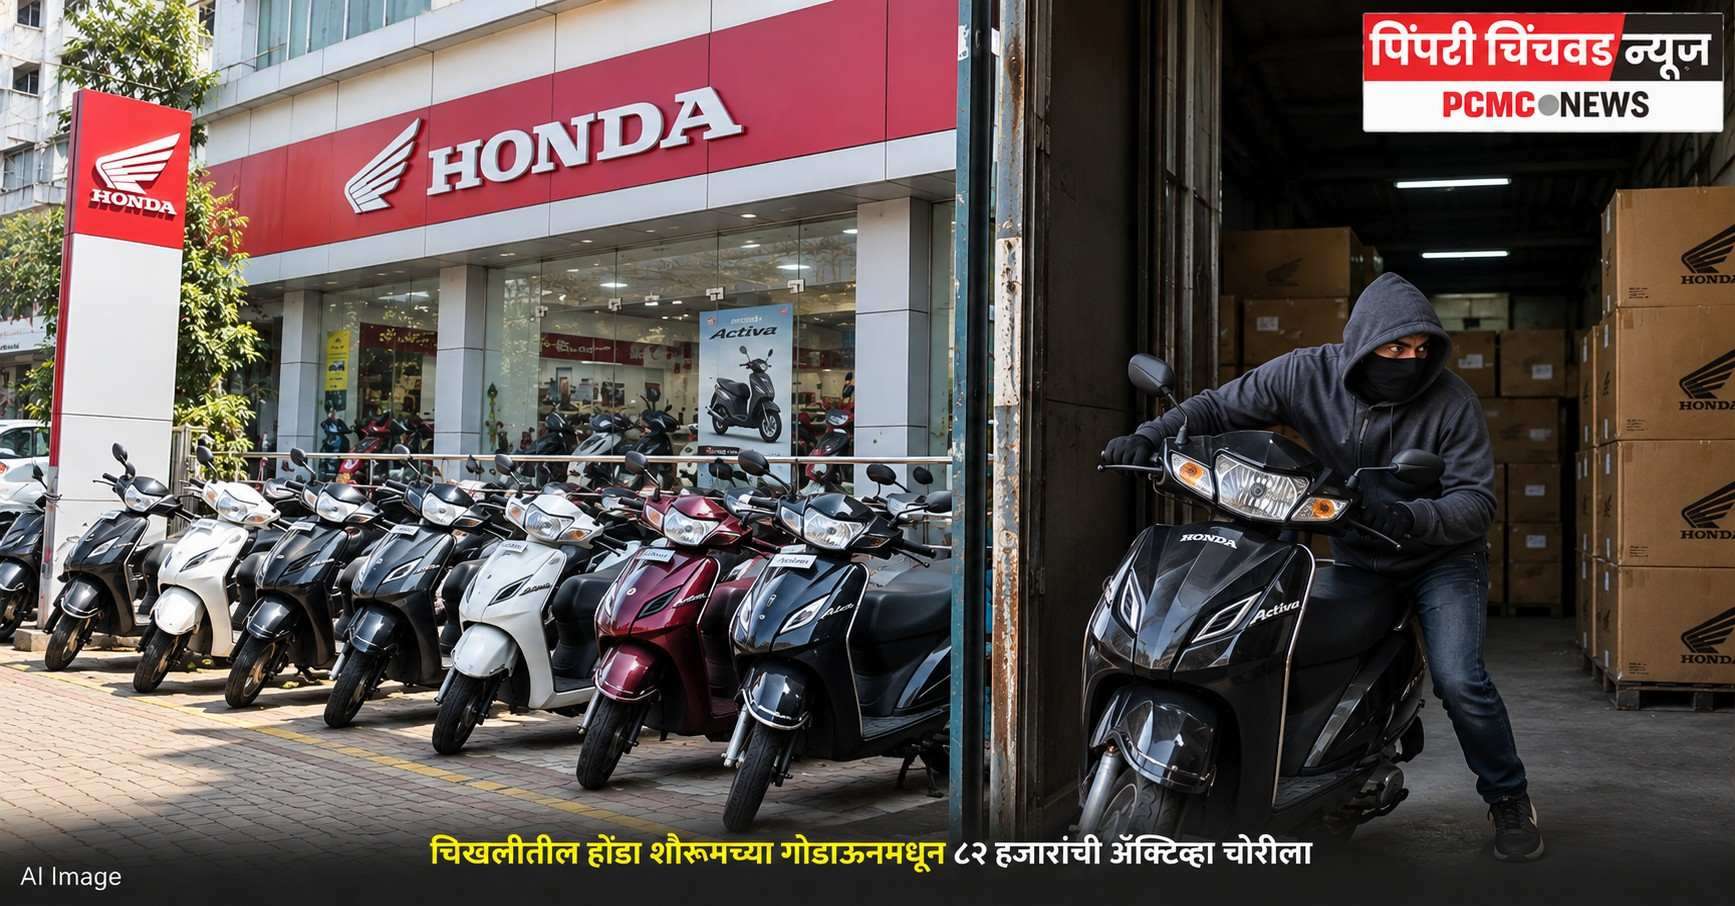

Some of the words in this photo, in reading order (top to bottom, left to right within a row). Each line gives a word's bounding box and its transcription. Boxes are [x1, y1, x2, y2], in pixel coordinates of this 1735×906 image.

[428, 86, 743, 196] HONDA
[91, 188, 177, 216] HONDA
[709, 325, 778, 340] Activa
[1180, 533, 1238, 550] HONDA
[1249, 600, 1301, 625] Activa
